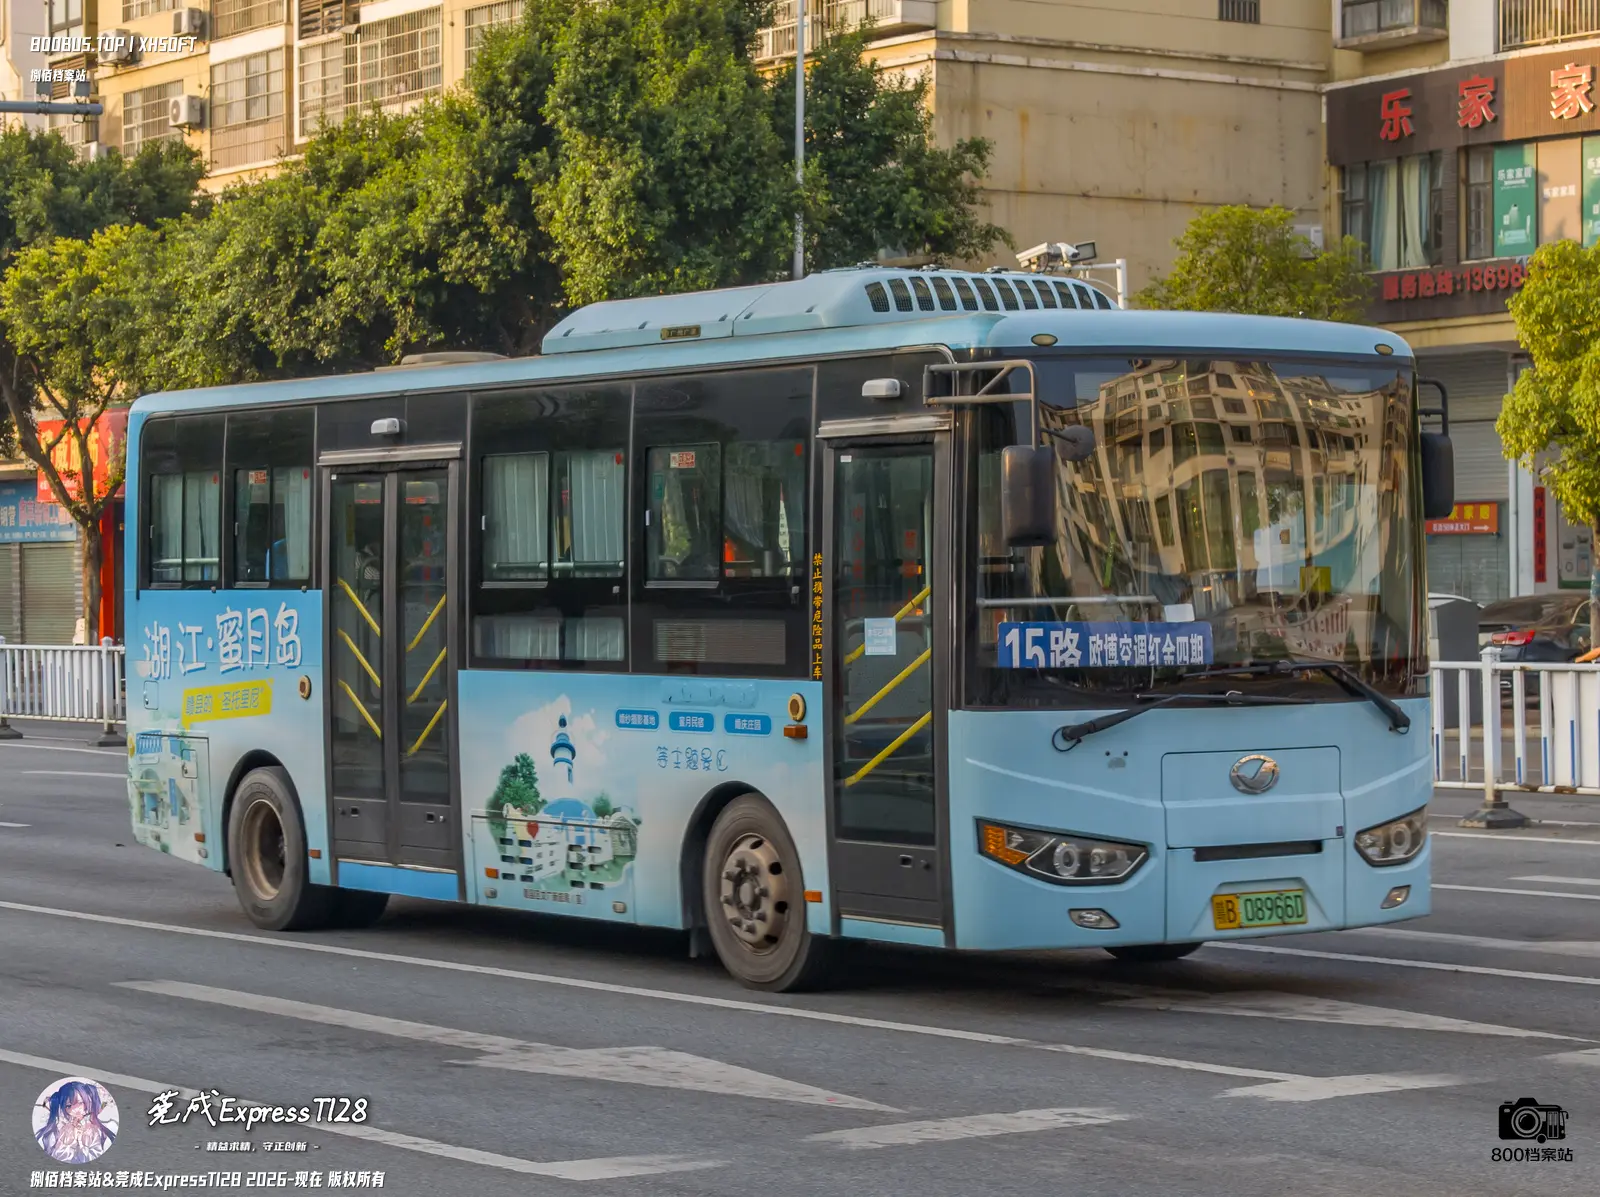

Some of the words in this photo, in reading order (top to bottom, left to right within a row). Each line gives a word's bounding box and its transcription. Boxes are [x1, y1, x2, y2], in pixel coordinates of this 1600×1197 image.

[812, 552, 823, 680] 禁止携带危险品上车
[1005, 627, 1082, 668] 15路
[1088, 633, 1204, 667] 欧博空调红金四期
